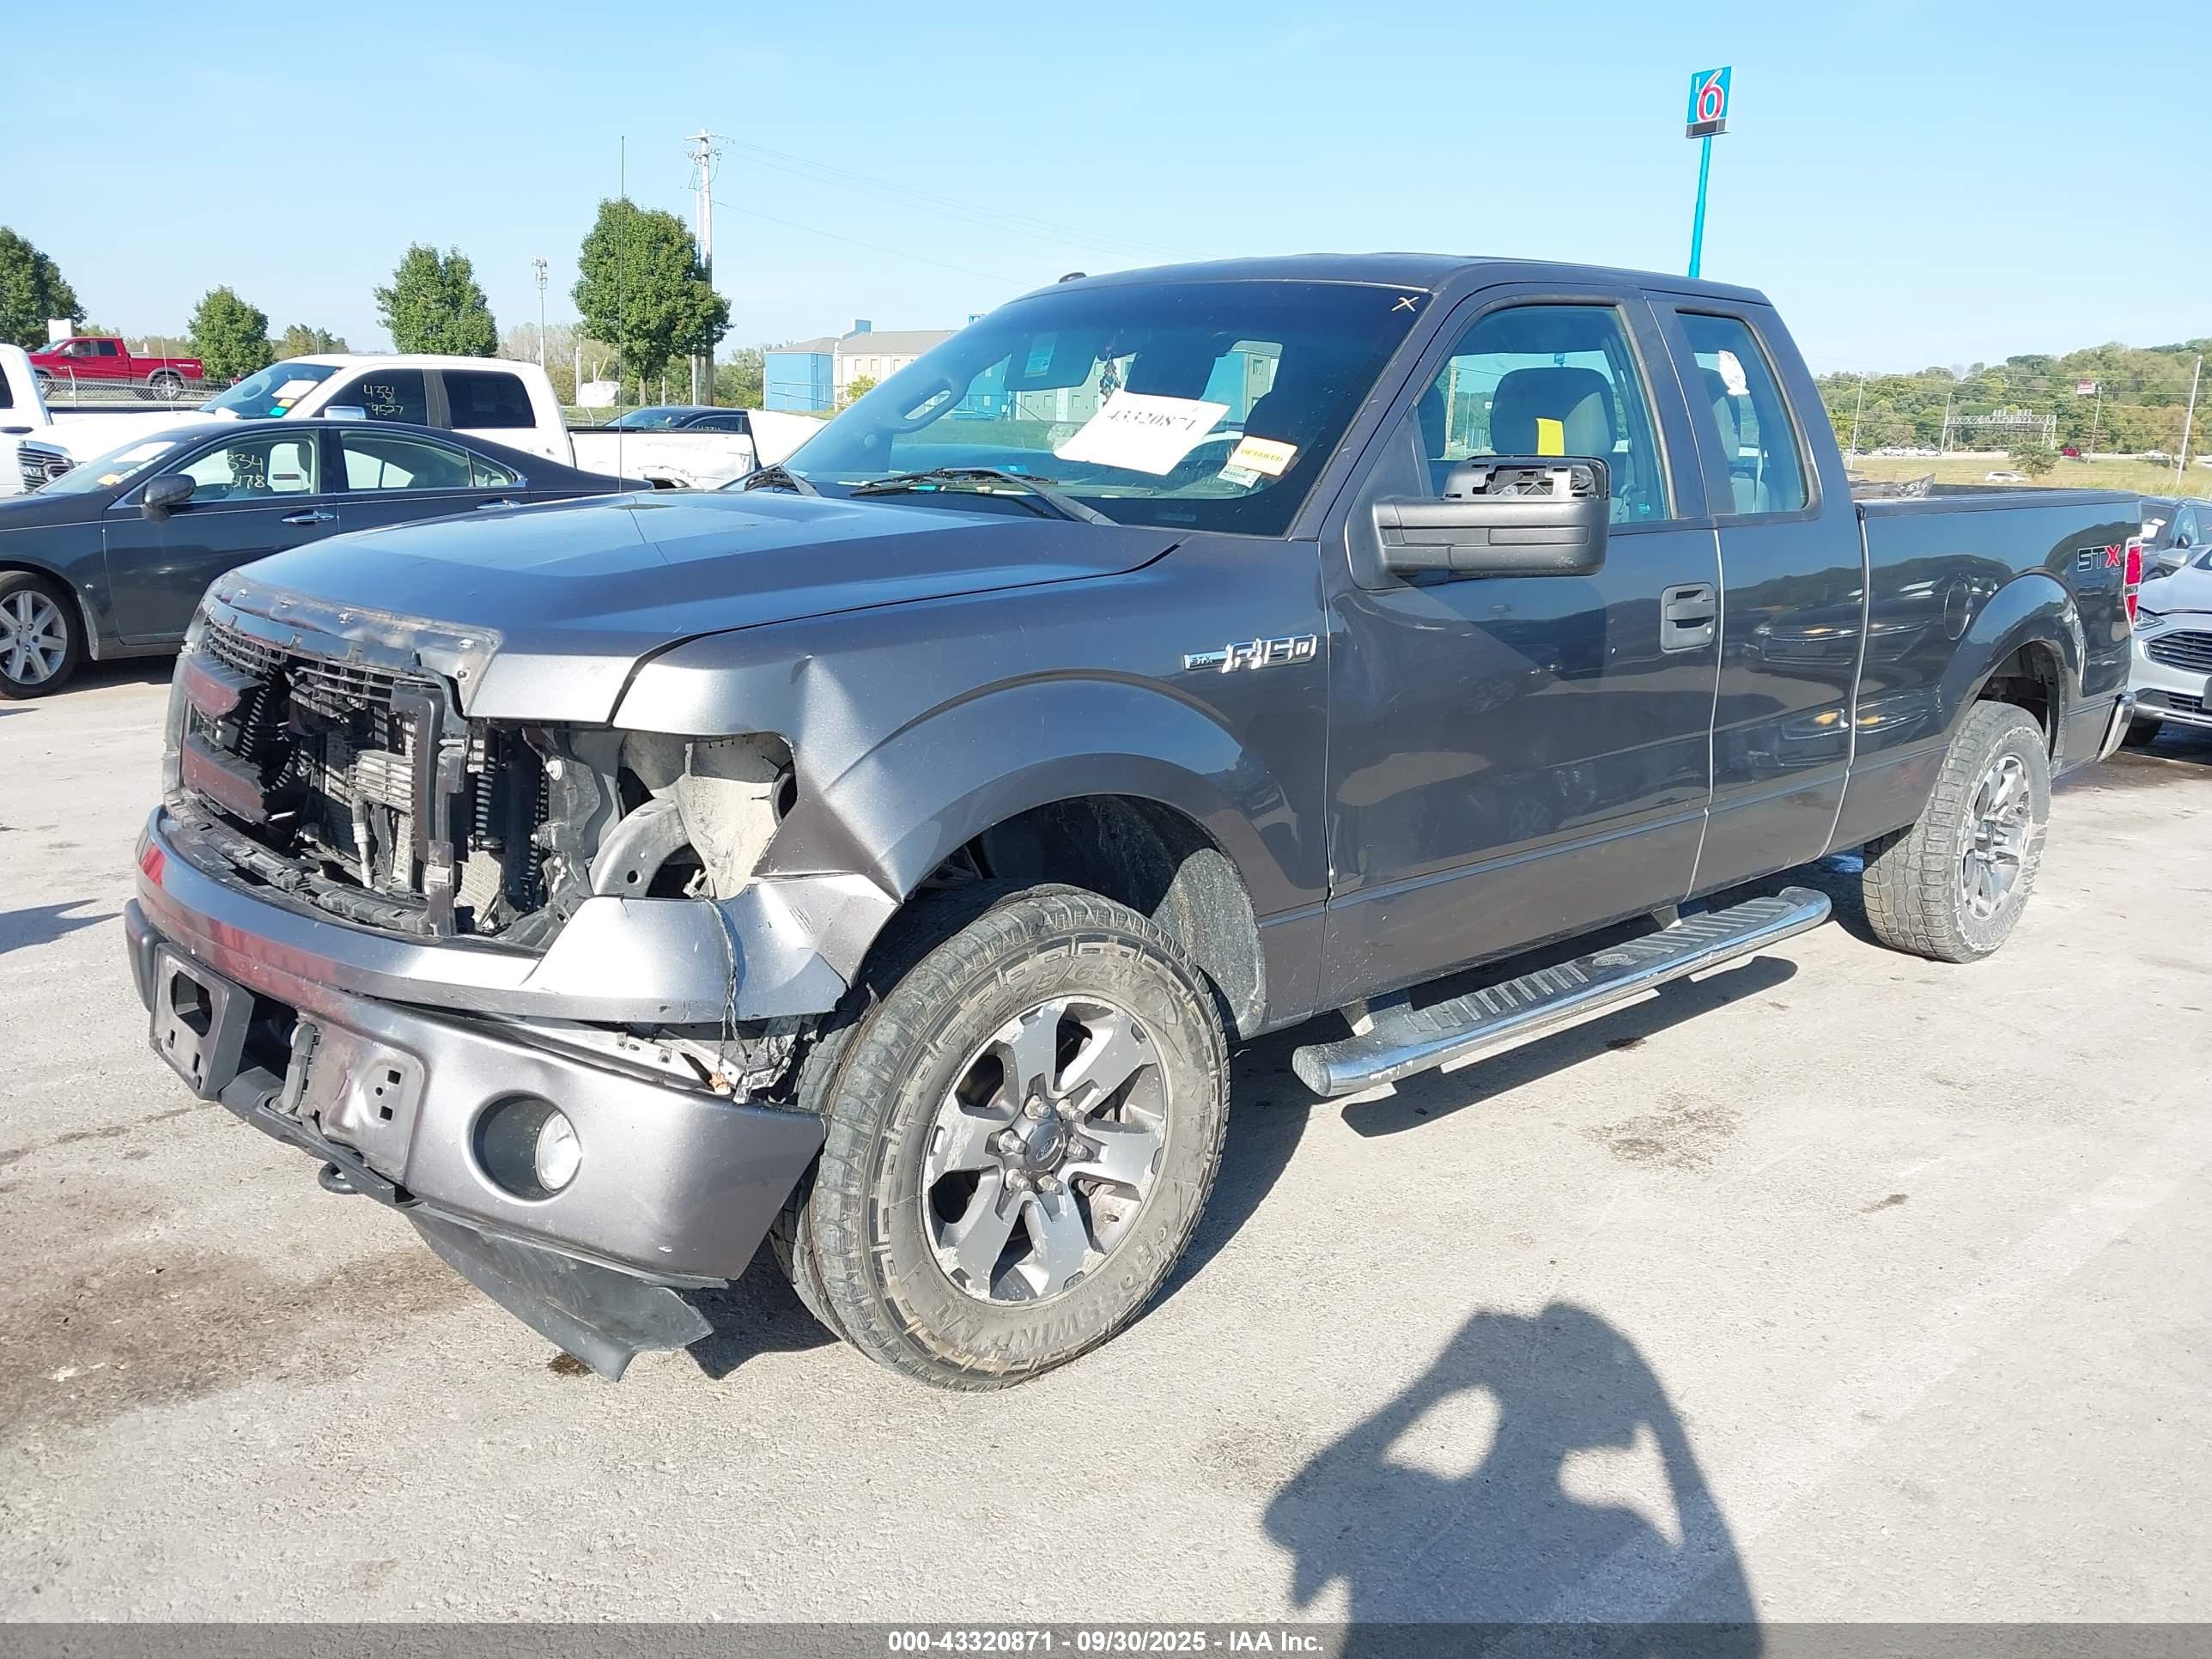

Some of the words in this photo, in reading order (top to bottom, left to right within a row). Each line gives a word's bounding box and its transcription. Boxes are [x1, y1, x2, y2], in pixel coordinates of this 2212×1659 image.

[1697, 70, 1724, 121] 6
[371, 404, 404, 416] 9527
[1241, 448, 1284, 462] DETAILED
[2077, 544, 2121, 572] STX
[1189, 656, 1213, 667] STX
